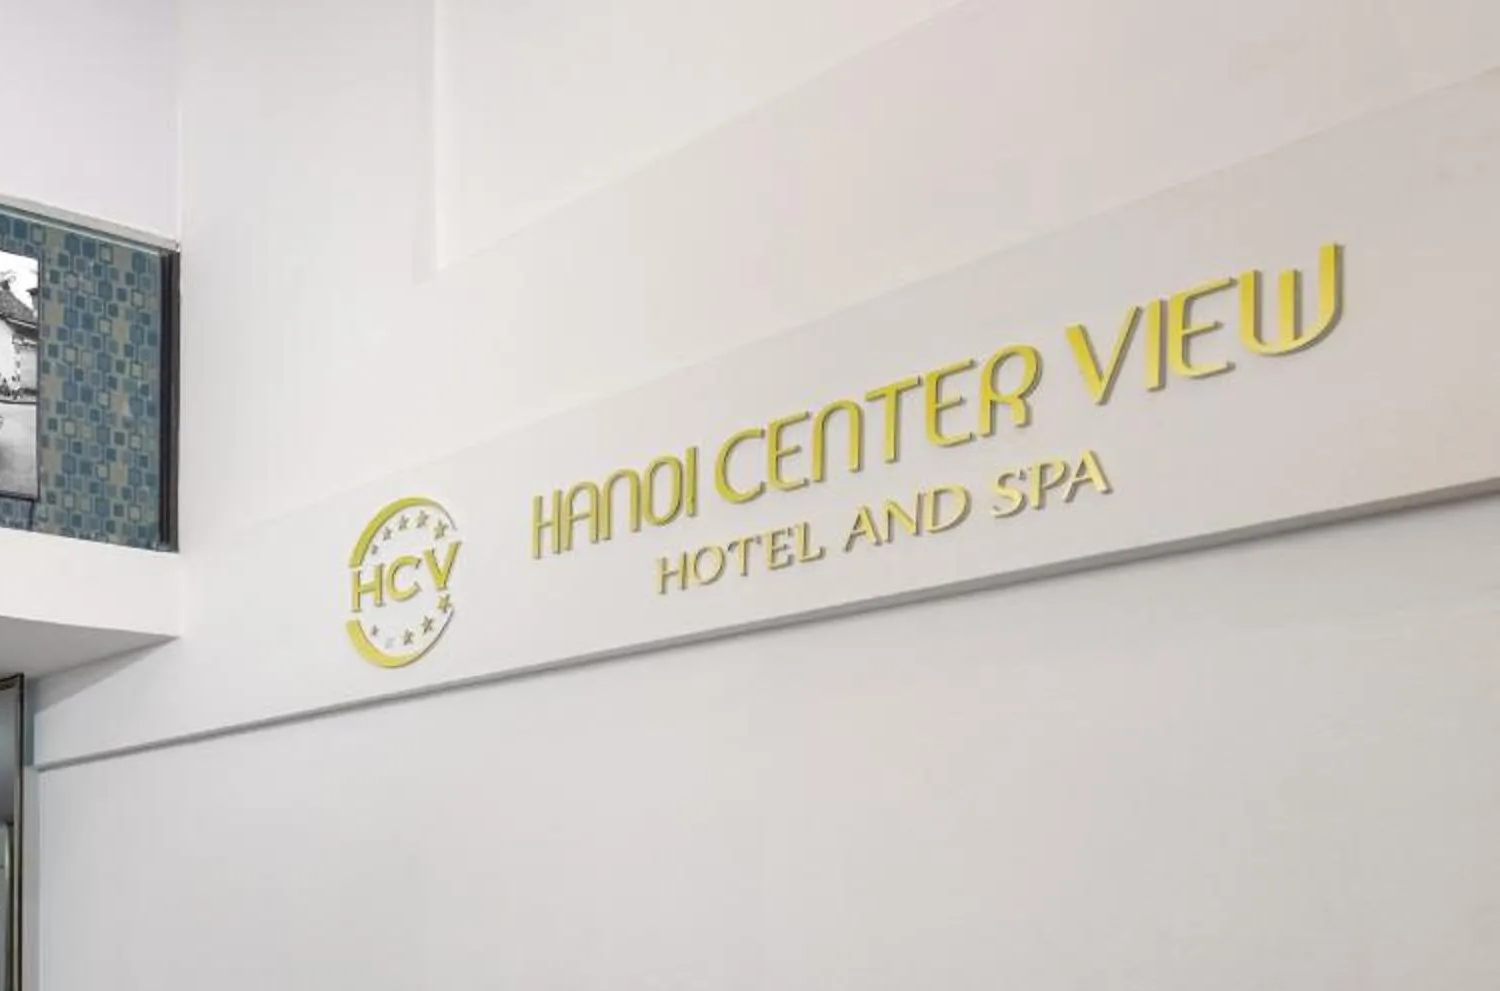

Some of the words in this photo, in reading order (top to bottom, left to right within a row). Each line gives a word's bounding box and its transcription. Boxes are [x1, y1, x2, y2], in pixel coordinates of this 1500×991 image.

[532, 446, 698, 558] HANOI
[714, 344, 1042, 503] CENTER
[1066, 243, 1345, 404] VIEW
[351, 541, 461, 612] HCV
[657, 522, 823, 594] HOTEL
[844, 486, 972, 549] AND
[991, 449, 1112, 516] SPA
